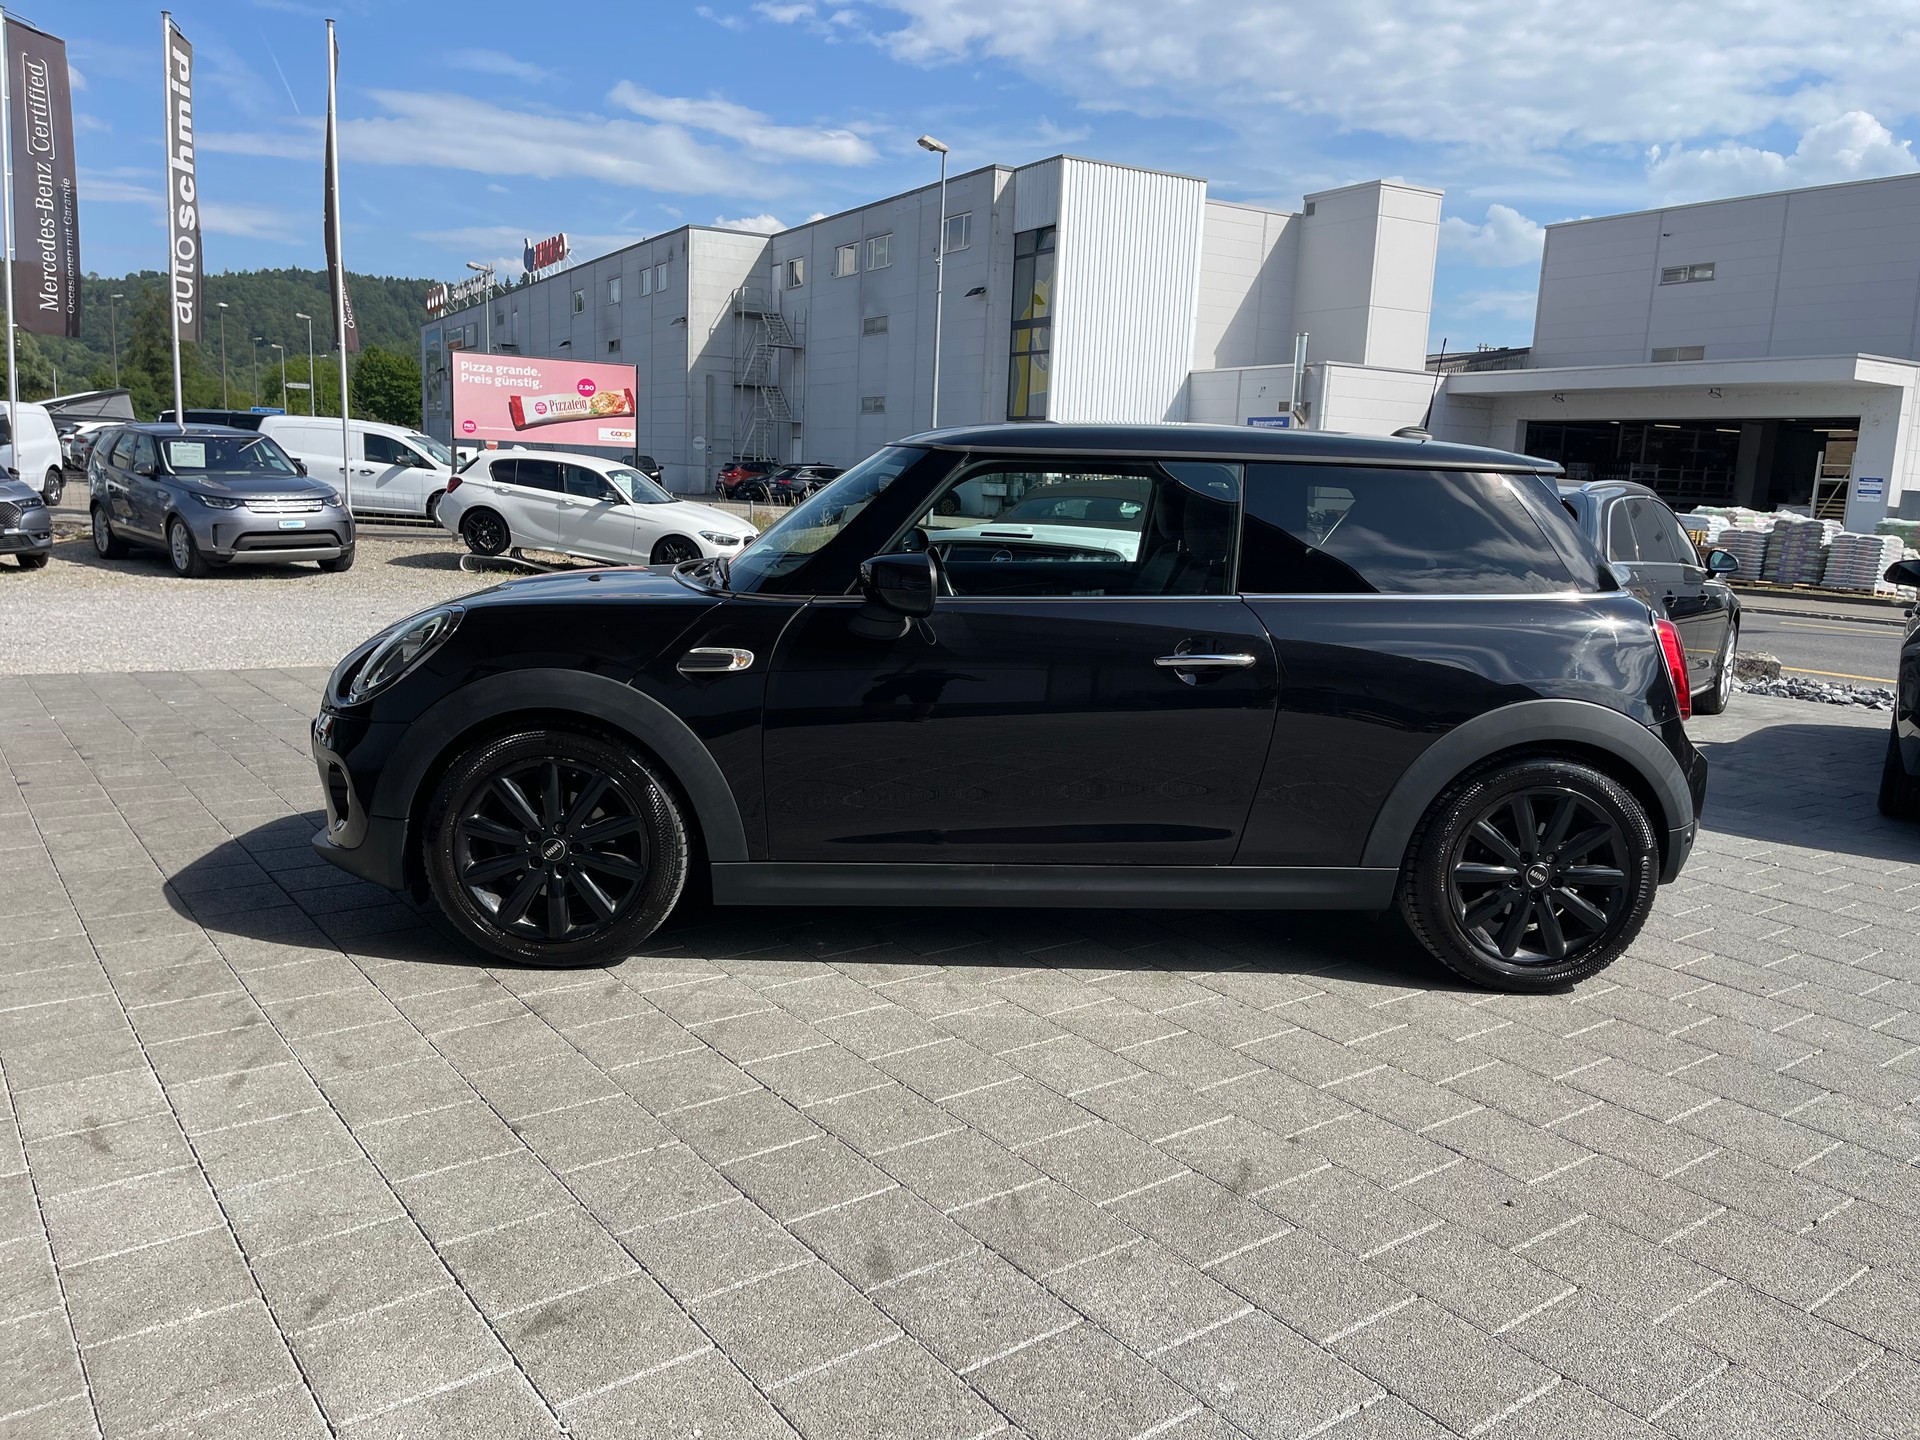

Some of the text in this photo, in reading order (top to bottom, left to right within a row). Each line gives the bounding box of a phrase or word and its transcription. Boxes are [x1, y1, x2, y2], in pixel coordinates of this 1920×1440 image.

[26, 61, 59, 313] Mercedes-Benz Certified
[60, 178, 76, 314] Occasionen mit Garantie
[460, 361, 542, 377] Pizza grande.
[461, 373, 543, 390] Preis günstig.
[548, 397, 588, 412] Pizzateig
[610, 430, 632, 438] coop
[545, 842, 561, 857] MINI
[1530, 870, 1546, 882] MINI
